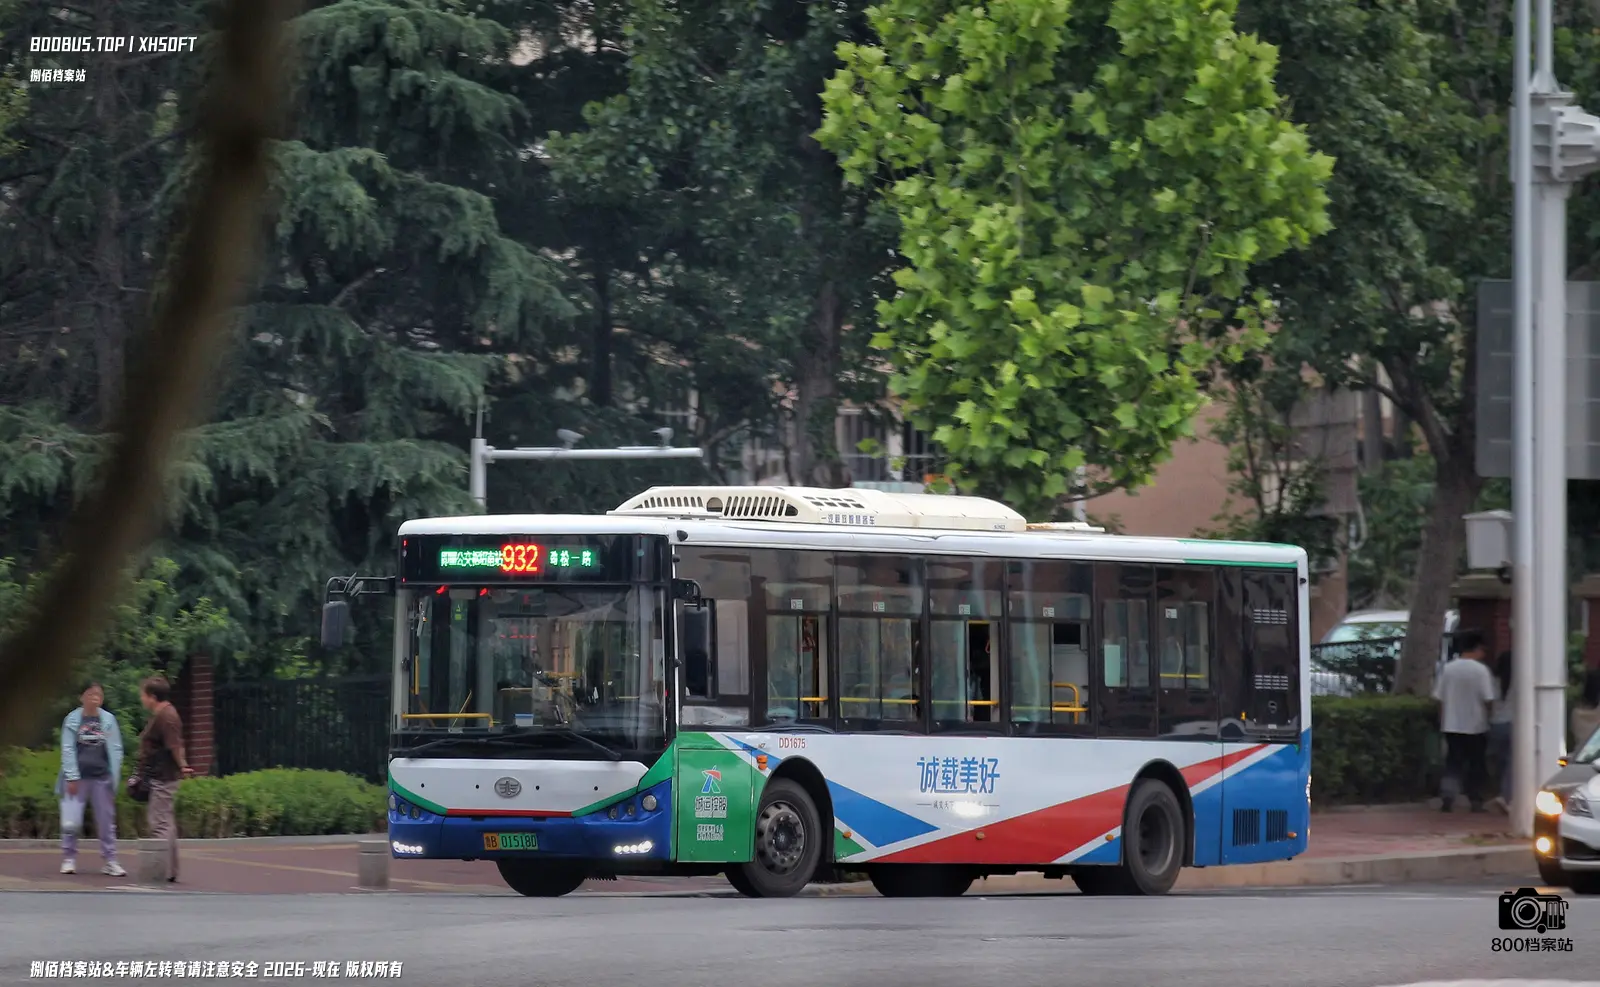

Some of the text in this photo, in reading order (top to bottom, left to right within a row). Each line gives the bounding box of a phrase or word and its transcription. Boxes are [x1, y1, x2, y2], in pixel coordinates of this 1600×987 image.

[502, 545, 538, 571] 932
[778, 737, 806, 749] DD1675
[916, 756, 1000, 794] 诚载美好
